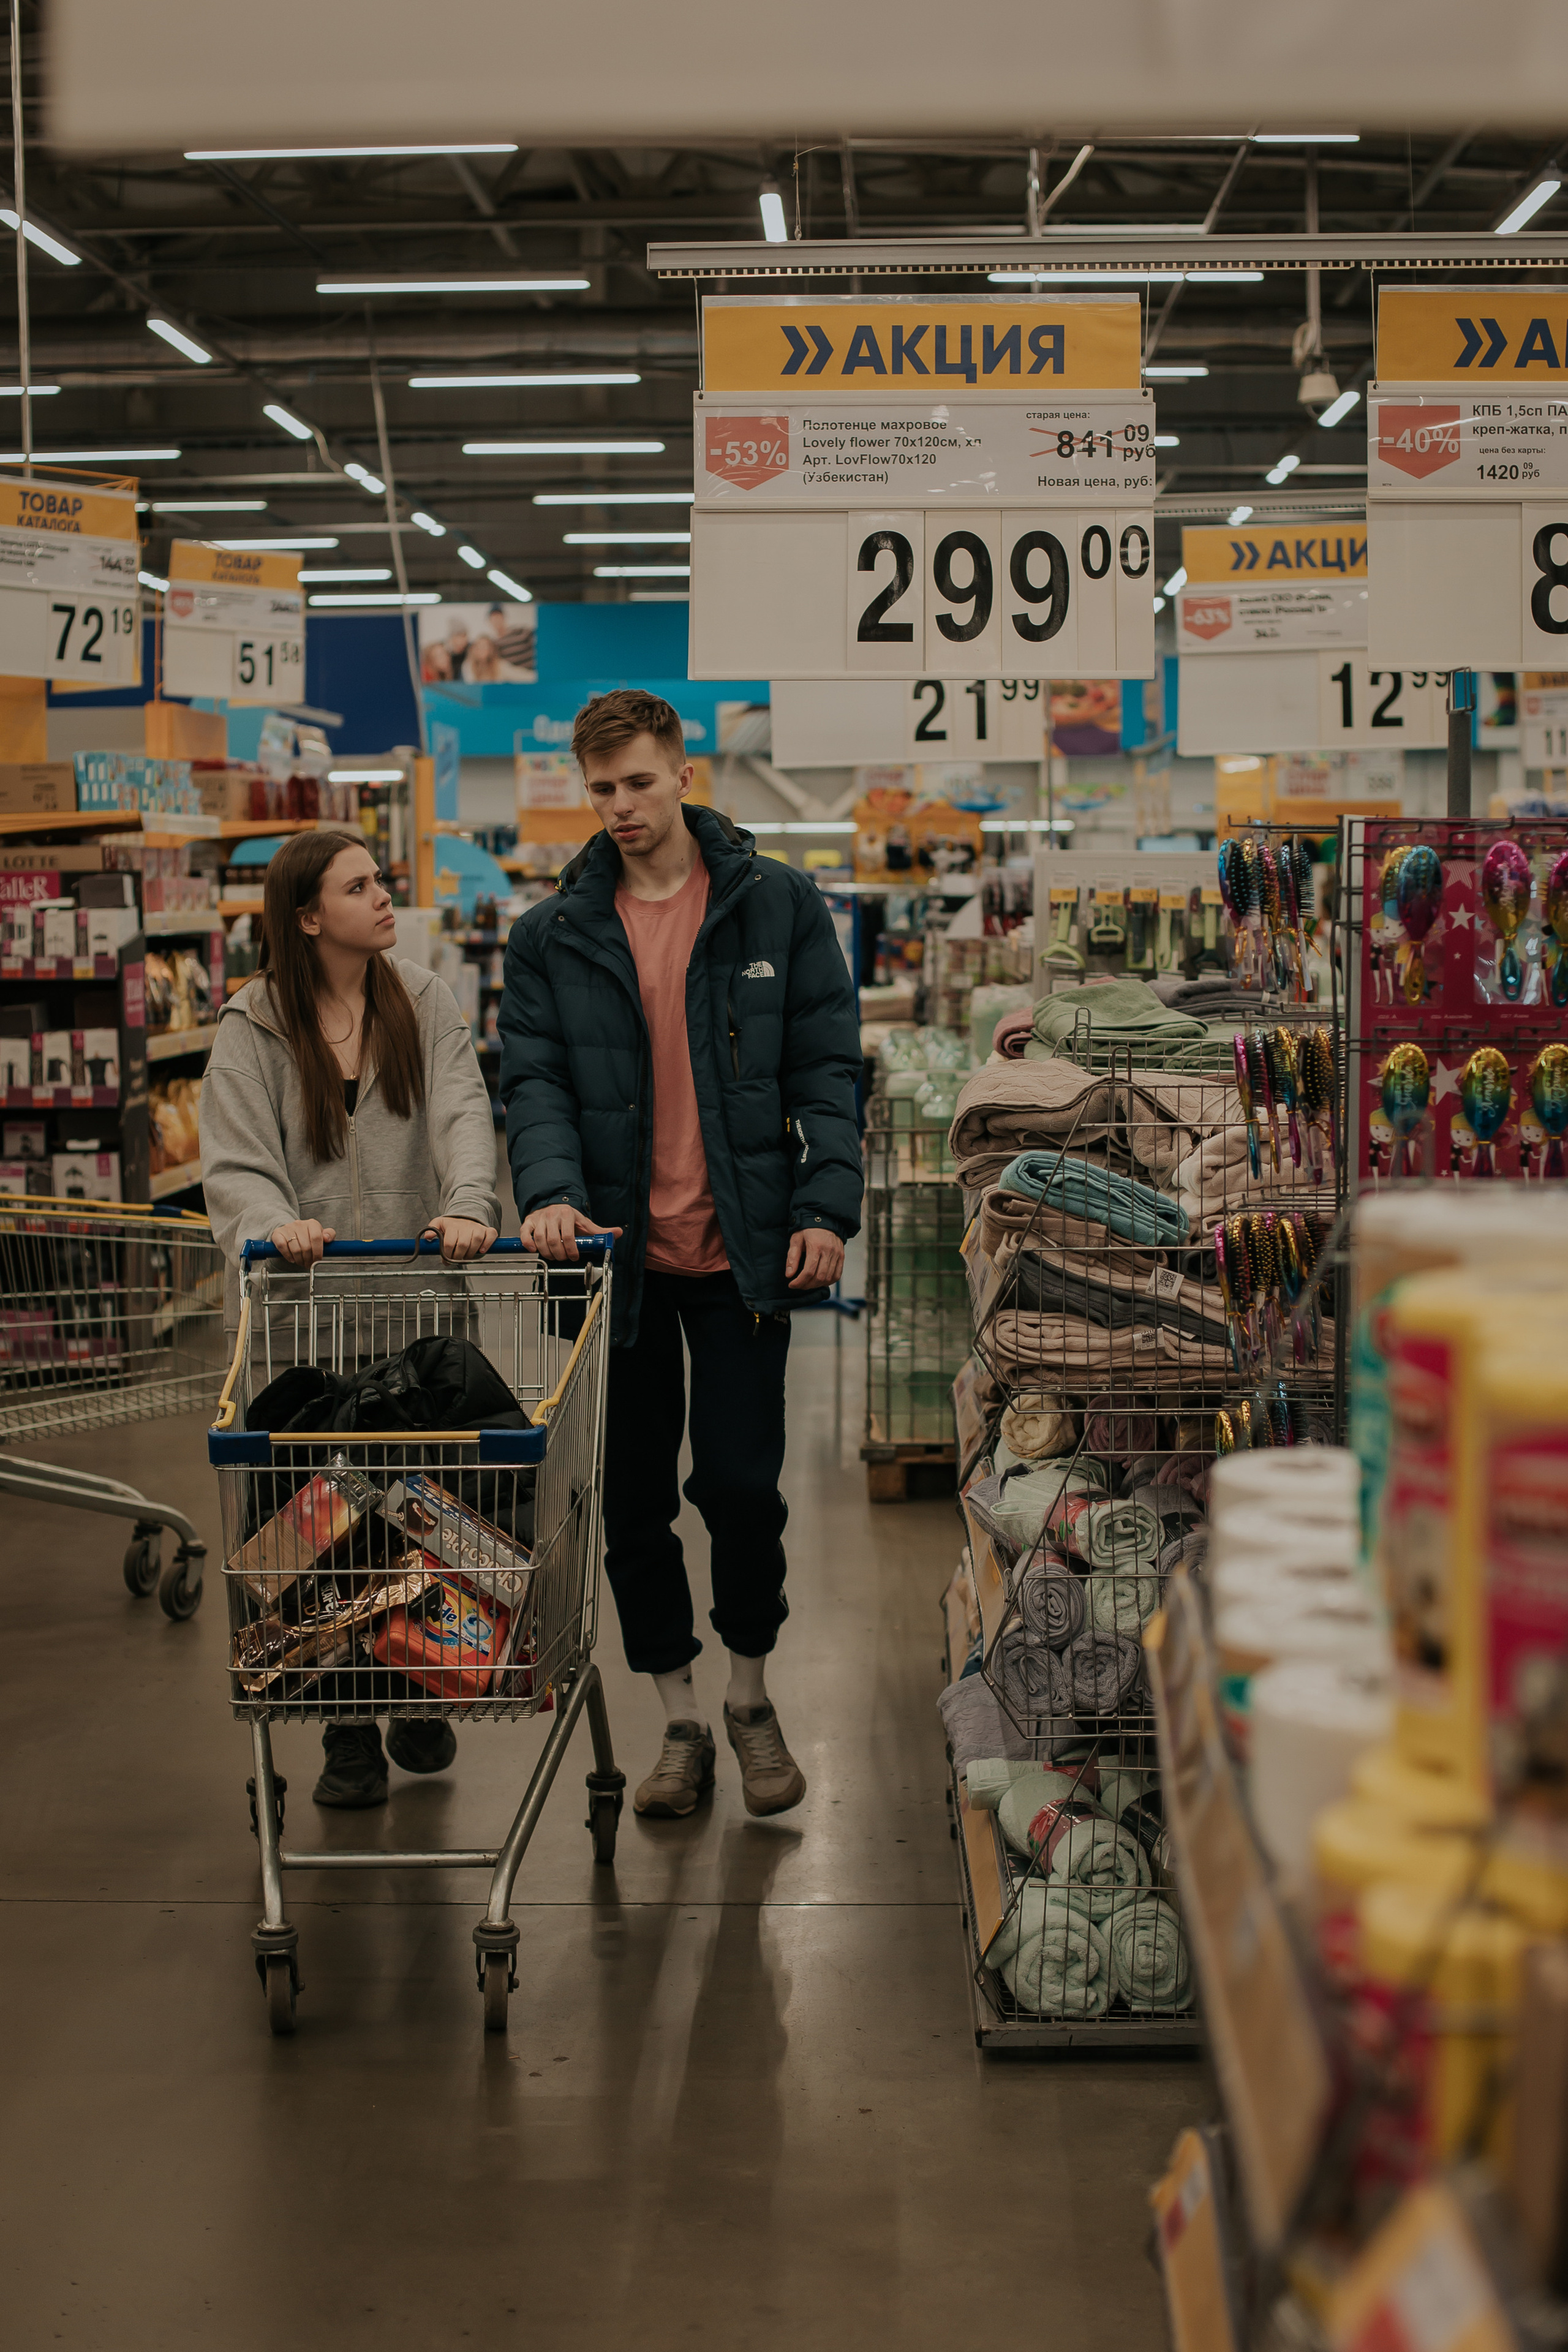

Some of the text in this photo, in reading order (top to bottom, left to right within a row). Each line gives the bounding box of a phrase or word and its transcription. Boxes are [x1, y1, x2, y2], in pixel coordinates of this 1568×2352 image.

[841, 325, 1065, 383] АКЦИЯ
[1515, 318, 1568, 369] А
[1472, 405, 1501, 416] КПБ
[1507, 405, 1542, 418] 1,5сп
[803, 420, 947, 432] Полотенце махровое
[1124, 424, 1150, 442] 09
[1472, 426, 1555, 437] креп-жатка,
[803, 437, 846, 450] Lovely
[850, 437, 890, 447] flower
[1057, 429, 1113, 458] 841
[1382, 428, 1459, 454] -40%
[710, 440, 786, 466] -53%
[803, 454, 937, 467] Арт. LovFlow70x120
[1123, 443, 1156, 462] руб
[803, 471, 889, 484] (Узбекистан)
[1038, 476, 1153, 489] Новая цена, руб:
[1477, 464, 1519, 480] 1420
[1522, 470, 1540, 480] руб
[19, 491, 83, 516] ТОВАР
[17, 514, 81, 533] КАТАЛОГА
[215, 552, 263, 570] ТОВАР
[1081, 524, 1150, 579] 00
[856, 529, 1070, 643] 299
[1531, 522, 1568, 635] 8
[112, 606, 134, 635] 19
[52, 603, 104, 663] 72
[239, 641, 275, 686] 51
[1332, 663, 1403, 727] 12
[913, 680, 986, 741] 21
[742, 967, 764, 976] NORTH
